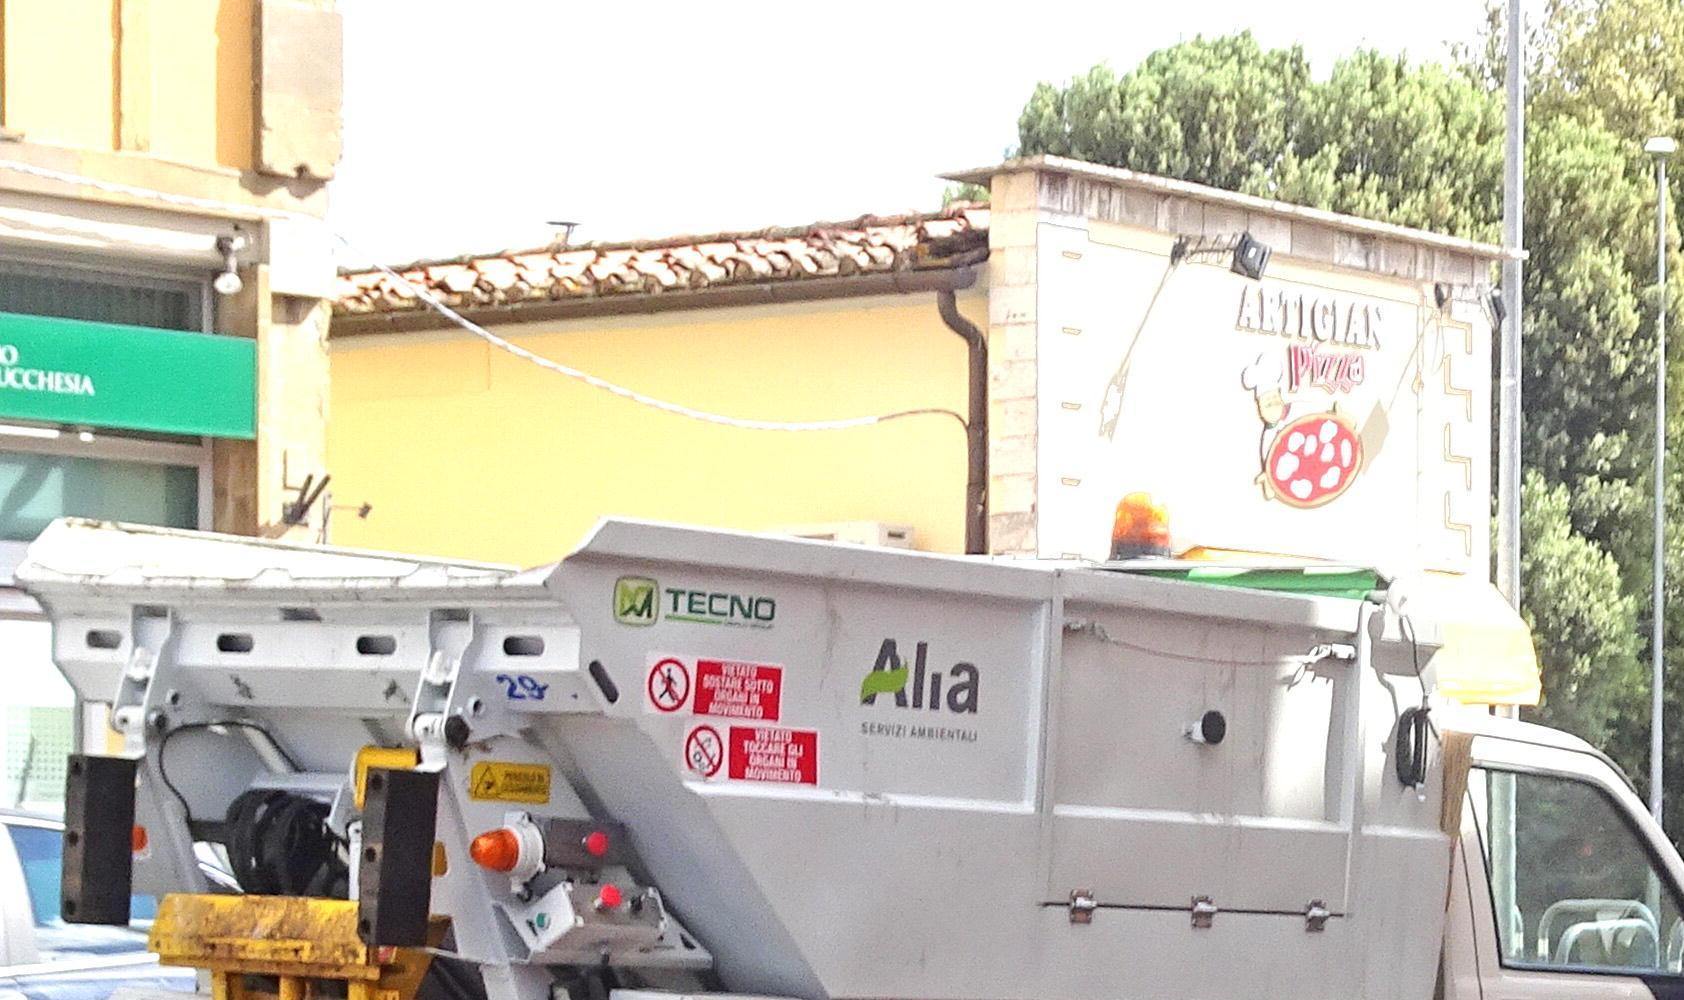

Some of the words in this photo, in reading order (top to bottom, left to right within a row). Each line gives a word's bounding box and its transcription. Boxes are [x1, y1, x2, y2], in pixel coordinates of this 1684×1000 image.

[665, 587, 776, 621] TECNO
[721, 663, 757, 678] VIETATO
[861, 638, 979, 714] Alia
[708, 702, 764, 718] MOVIMENTO
[755, 728, 792, 743] VIETATO
[861, 721, 907, 738] SERVIZI
[911, 725, 978, 742] AMBIENTALI
[743, 740, 785, 755] TOCCARE
[787, 744, 803, 757] GLI
[745, 766, 802, 782] MOVIMENTO
